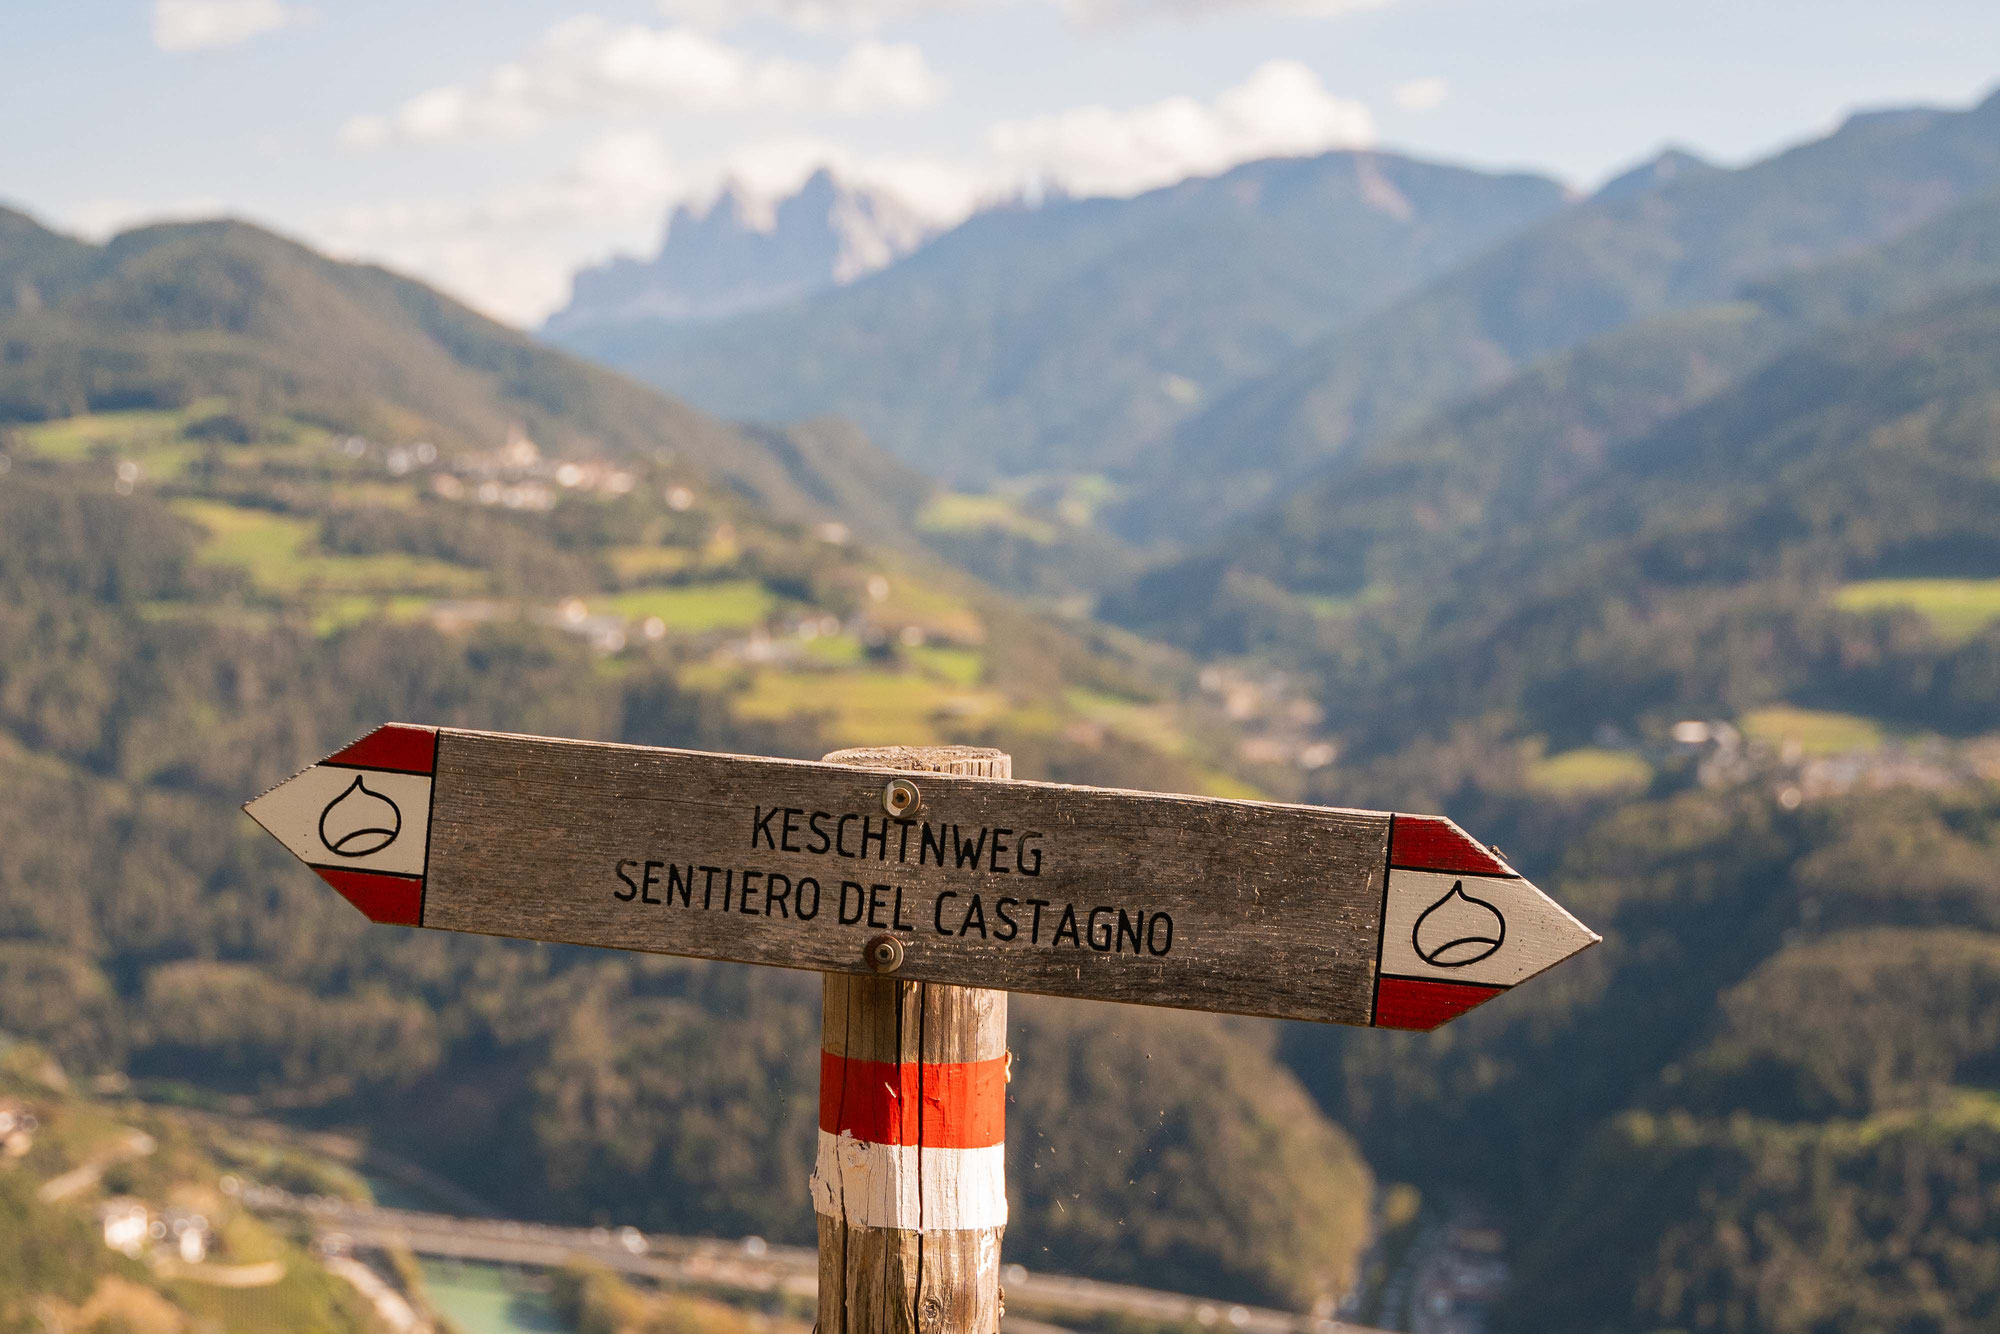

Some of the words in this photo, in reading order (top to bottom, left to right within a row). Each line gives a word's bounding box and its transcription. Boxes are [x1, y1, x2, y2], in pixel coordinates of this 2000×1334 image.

[751, 805, 1043, 877] KESCHTNWEG
[614, 858, 820, 921] SENTIERO
[838, 880, 914, 933] DEL
[934, 890, 1174, 957] CASTAGNO
